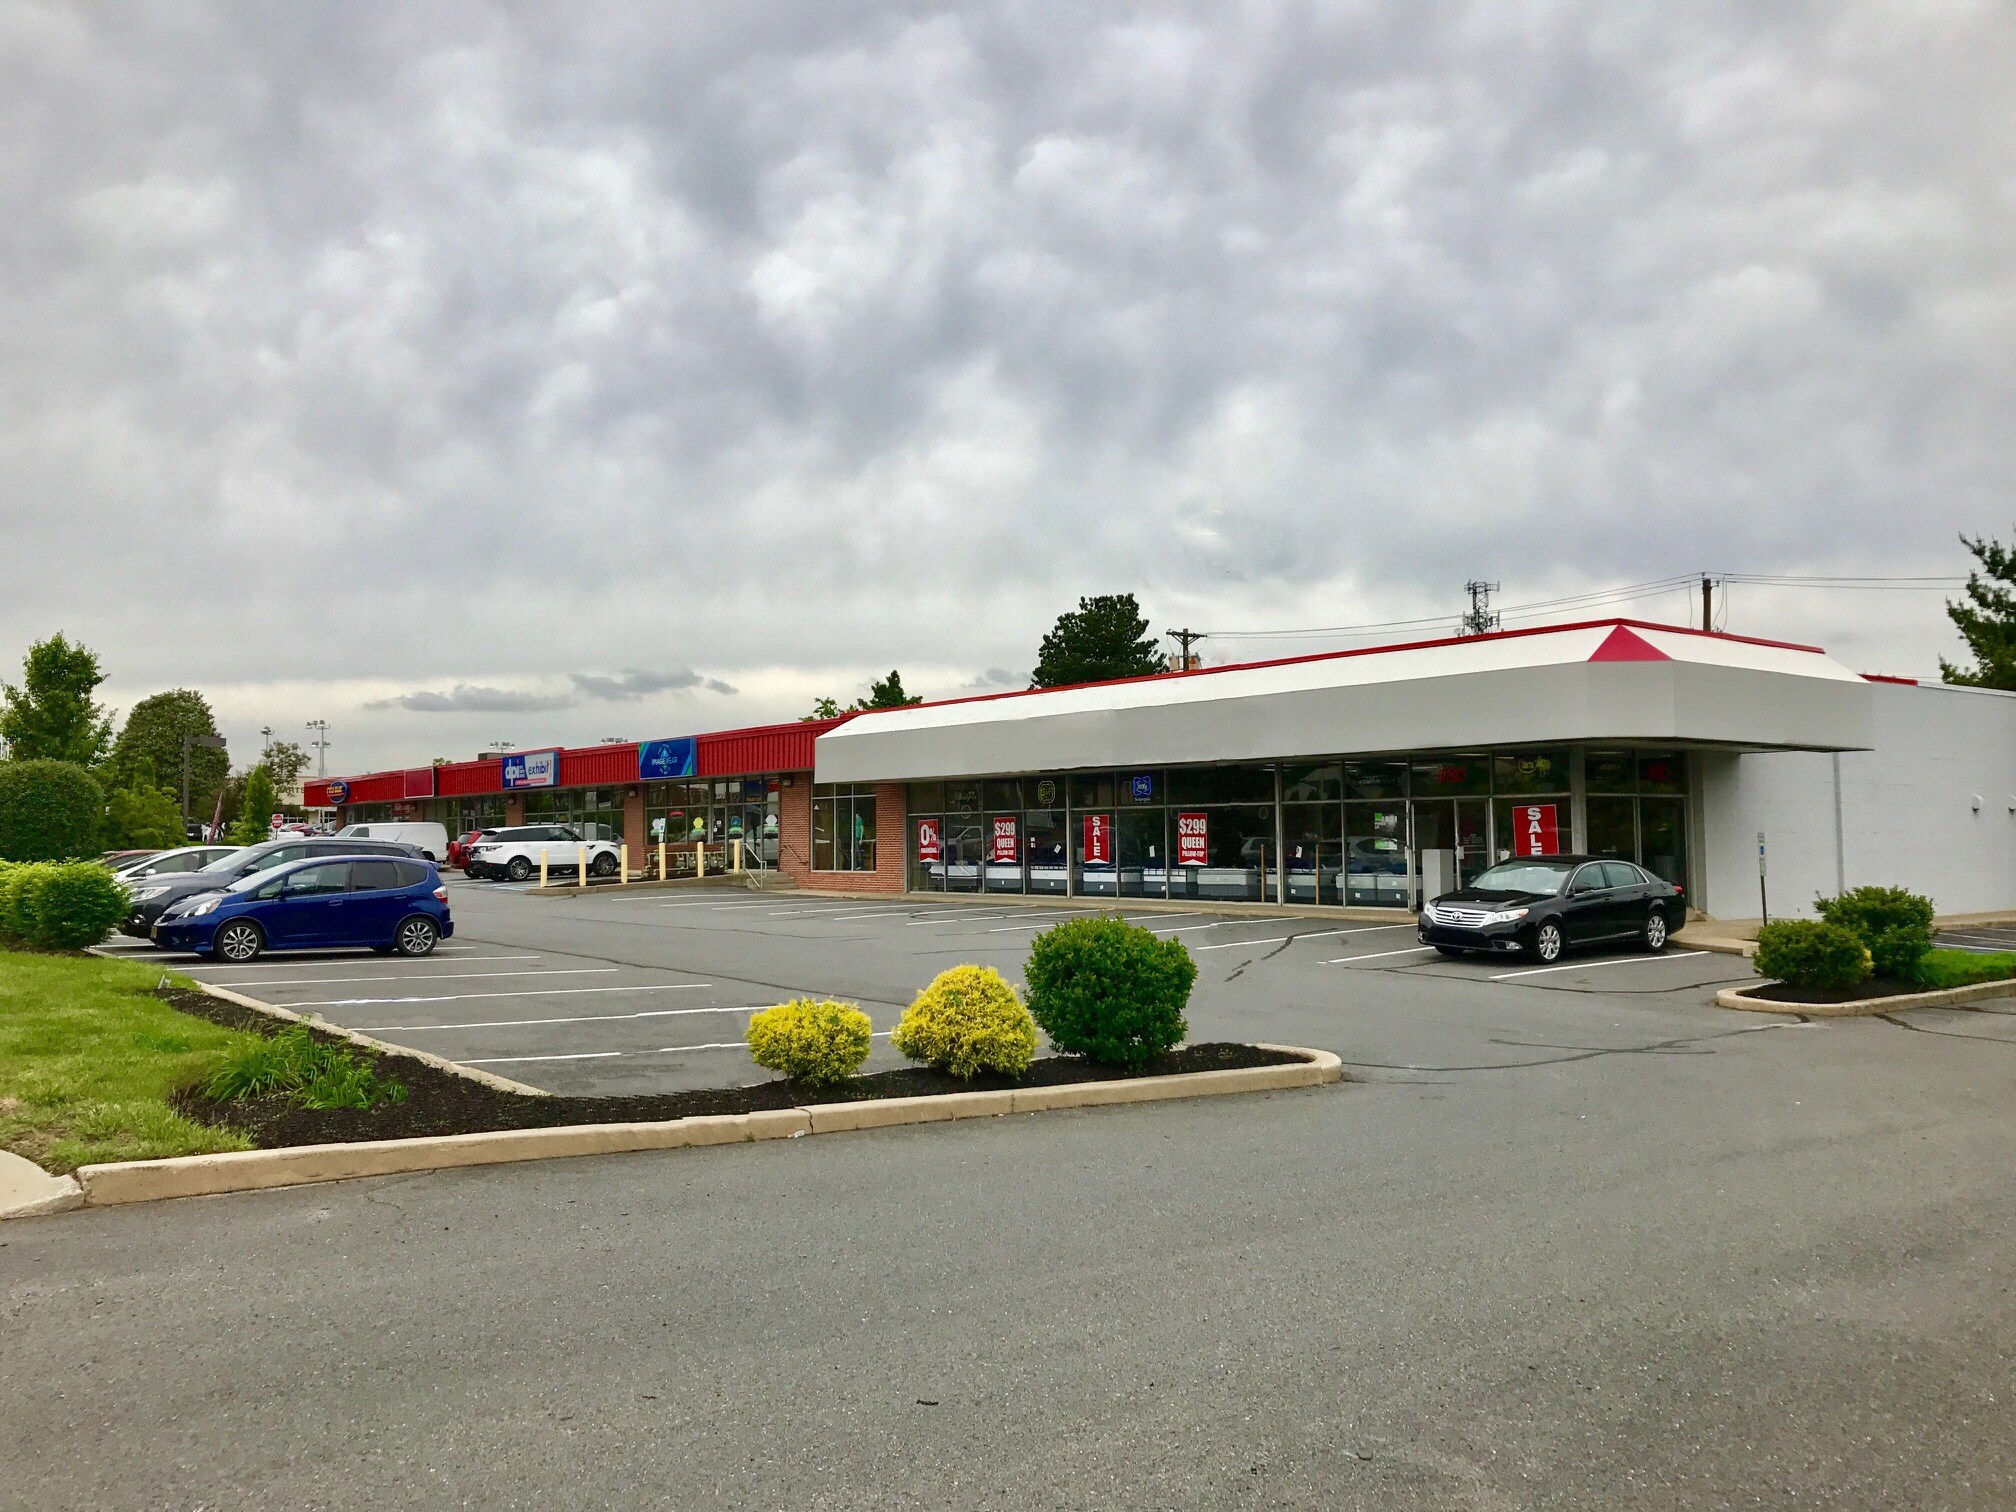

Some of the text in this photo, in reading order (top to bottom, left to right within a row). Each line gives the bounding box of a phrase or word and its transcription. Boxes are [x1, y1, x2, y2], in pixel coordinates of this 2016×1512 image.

[920, 824, 937, 846] 0%
[994, 821, 1015, 836] $299
[1179, 818, 1206, 835] $299
[1527, 807, 1543, 855] SALE
[996, 837, 1014, 850] QUEEN
[1092, 816, 1101, 857] SALE
[1181, 837, 1205, 849] QUEEN
